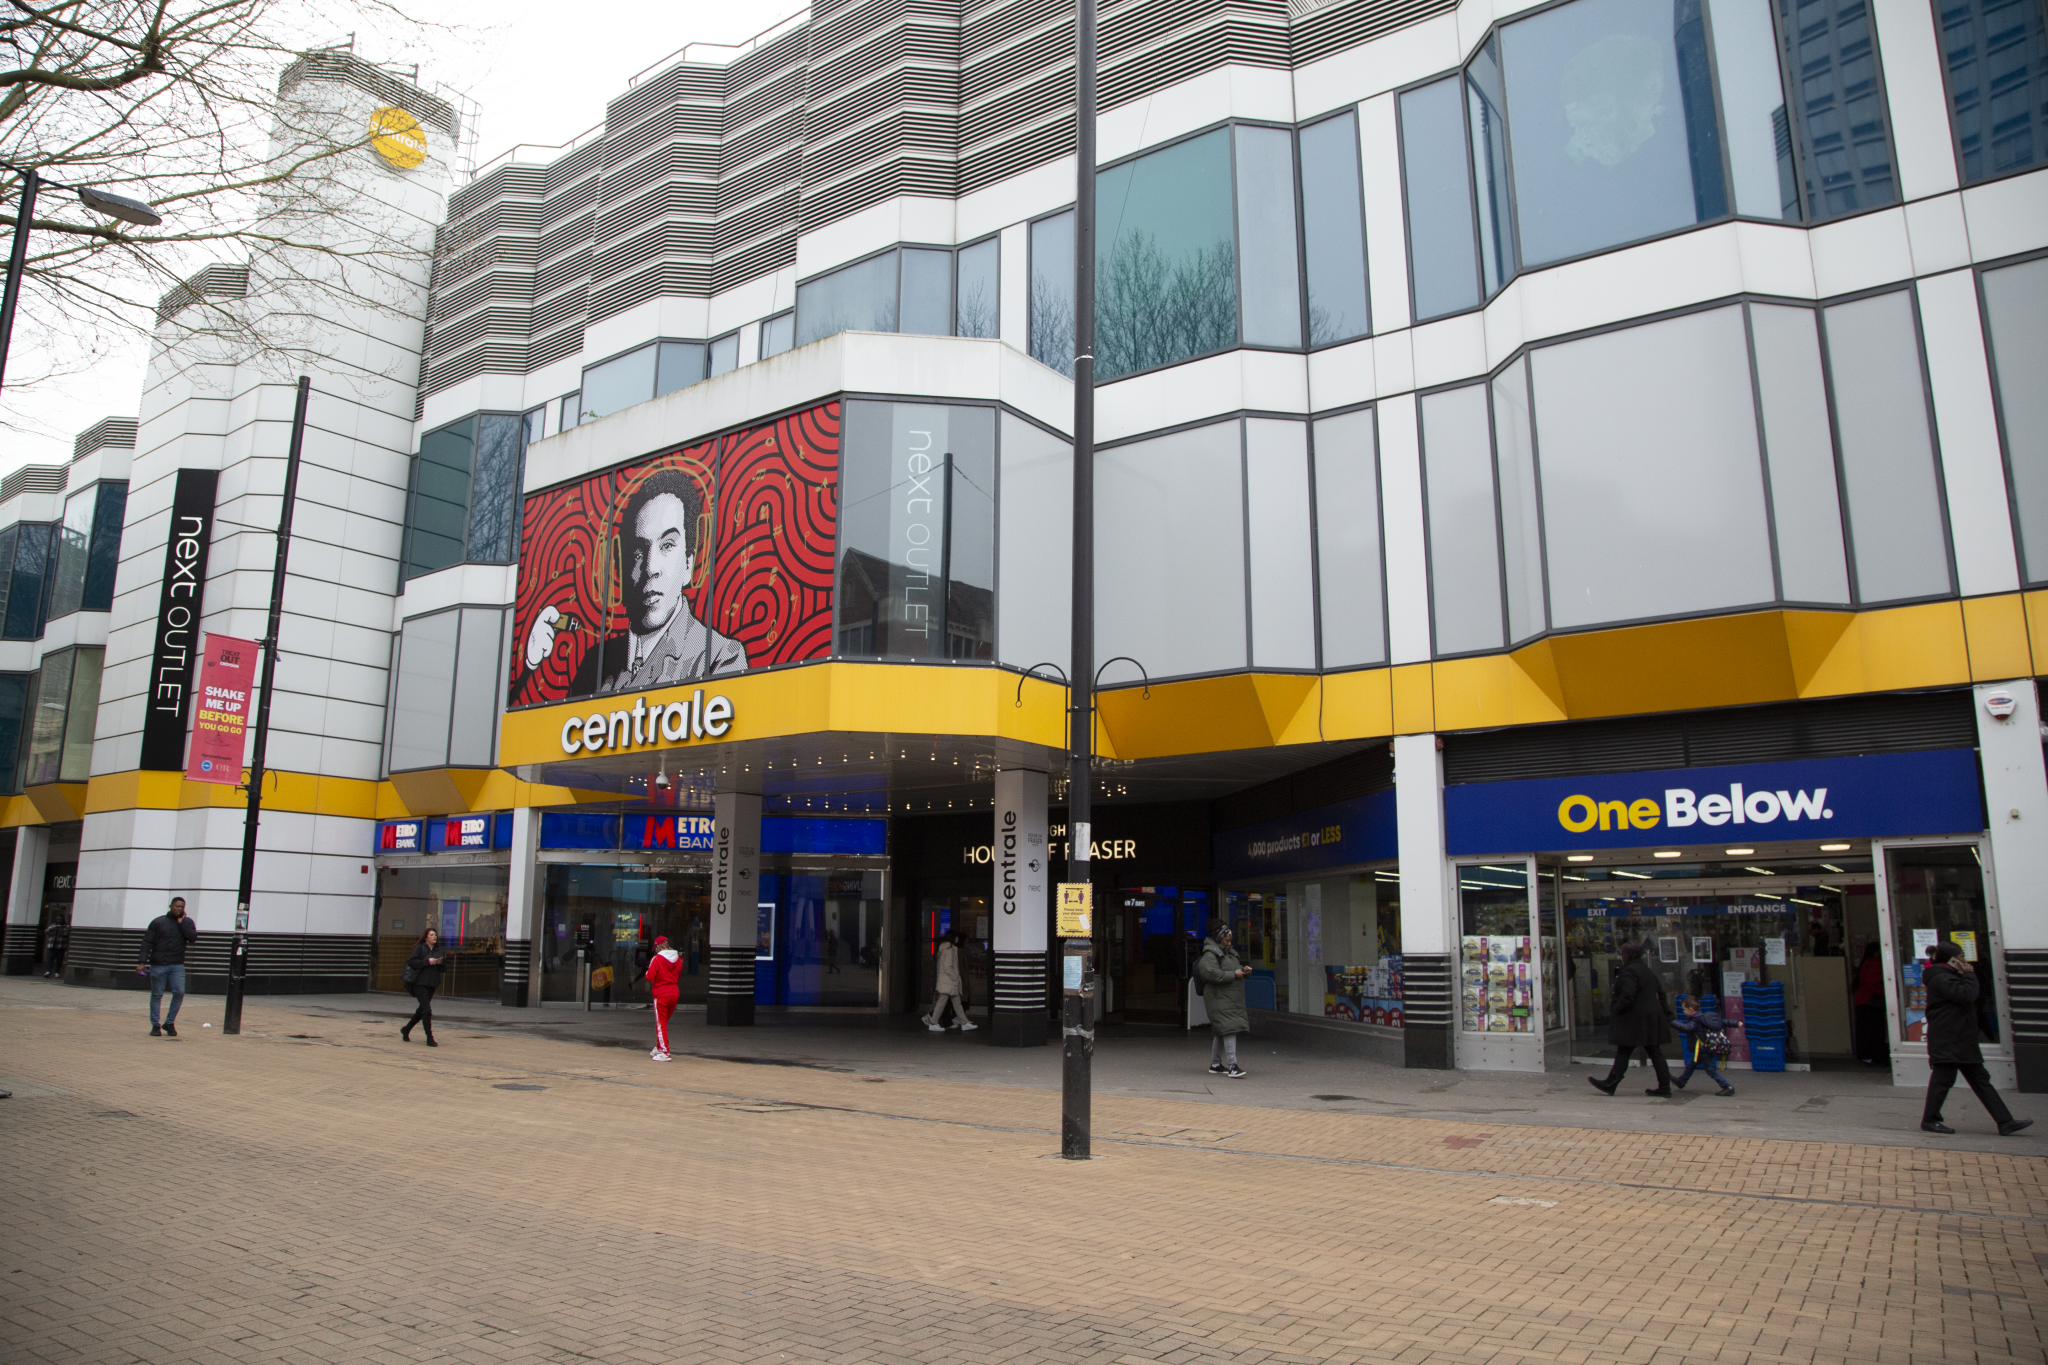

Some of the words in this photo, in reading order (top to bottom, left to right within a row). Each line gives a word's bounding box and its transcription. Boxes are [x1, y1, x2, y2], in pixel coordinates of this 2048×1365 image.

[907, 430, 933, 514] next
[170, 516, 203, 598] next
[905, 523, 930, 639] OUTLET
[156, 606, 191, 717] OUTLET
[220, 655, 240, 665] OUT
[221, 649, 240, 657] TREAT
[205, 685, 245, 702] SHAKE
[205, 698, 225, 710] ME
[225, 701, 241, 713] UP
[199, 709, 244, 726] BEFORE
[561, 689, 735, 754] centrale
[199, 721, 216, 731] YOU
[230, 727, 242, 735] GO
[381, 824, 417, 849] METRO
[444, 819, 485, 846] METRO
[461, 835, 484, 846] BANK
[396, 839, 415, 849] BANK
[679, 836, 714, 849] BAN
[1266, 834, 1300, 858] products
[1302, 832, 1310, 847] £1
[1311, 832, 1320, 846] or
[1321, 825, 1341, 844] LESS
[684, 855, 691, 863] 7
[1064, 840, 1136, 861] FASER
[717, 827, 730, 915] centrale
[1001, 811, 1016, 915] centrale
[53, 875, 72, 888] next
[1587, 908, 1607, 917] EXIT
[1666, 906, 1689, 915] EXIT
[1727, 904, 1787, 914] ENTRANCE
